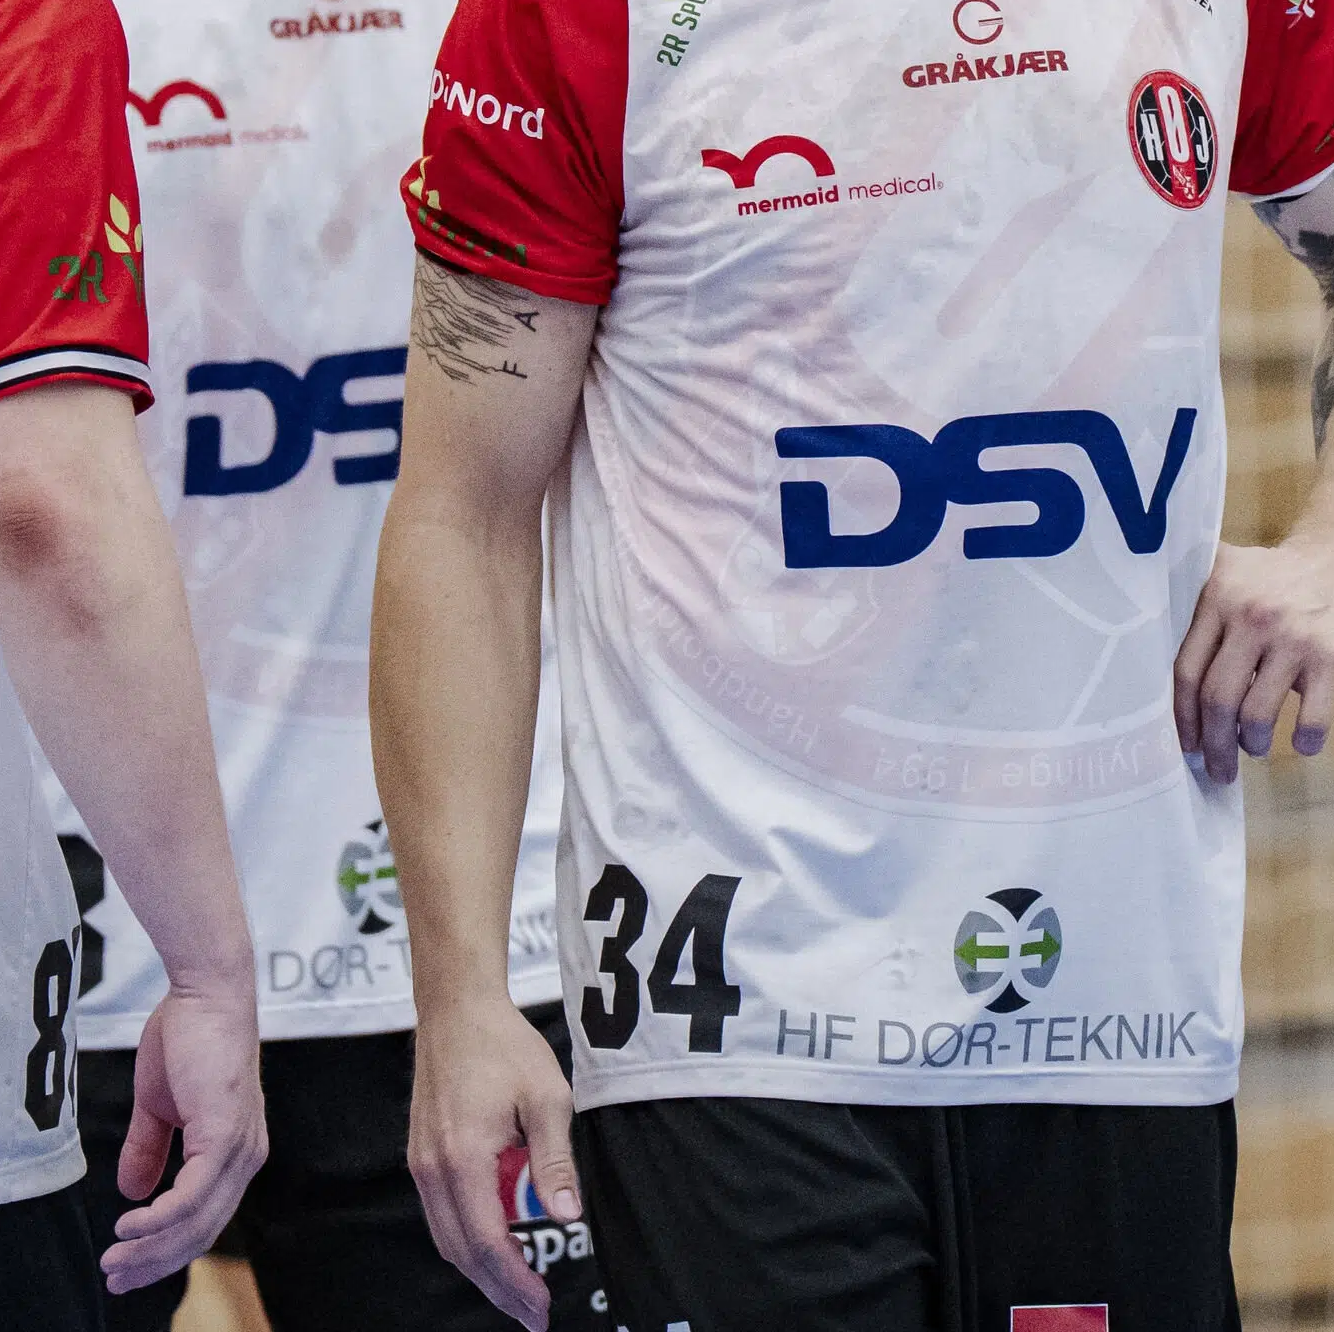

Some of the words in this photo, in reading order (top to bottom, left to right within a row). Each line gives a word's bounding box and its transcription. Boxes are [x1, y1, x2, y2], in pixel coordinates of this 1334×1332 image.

[656, 33, 691, 67] 2R
[902, 50, 1070, 88] GRÅKJÆR
[737, 184, 839, 216] mermaid
[183, 344, 409, 497] DS
[774, 407, 1198, 569] DSV
[581, 864, 742, 1055] 34
[25, 926, 78, 1133] 8
[776, 1008, 856, 1060] HF
[877, 1011, 1198, 1068] DØR-TEKNIK
